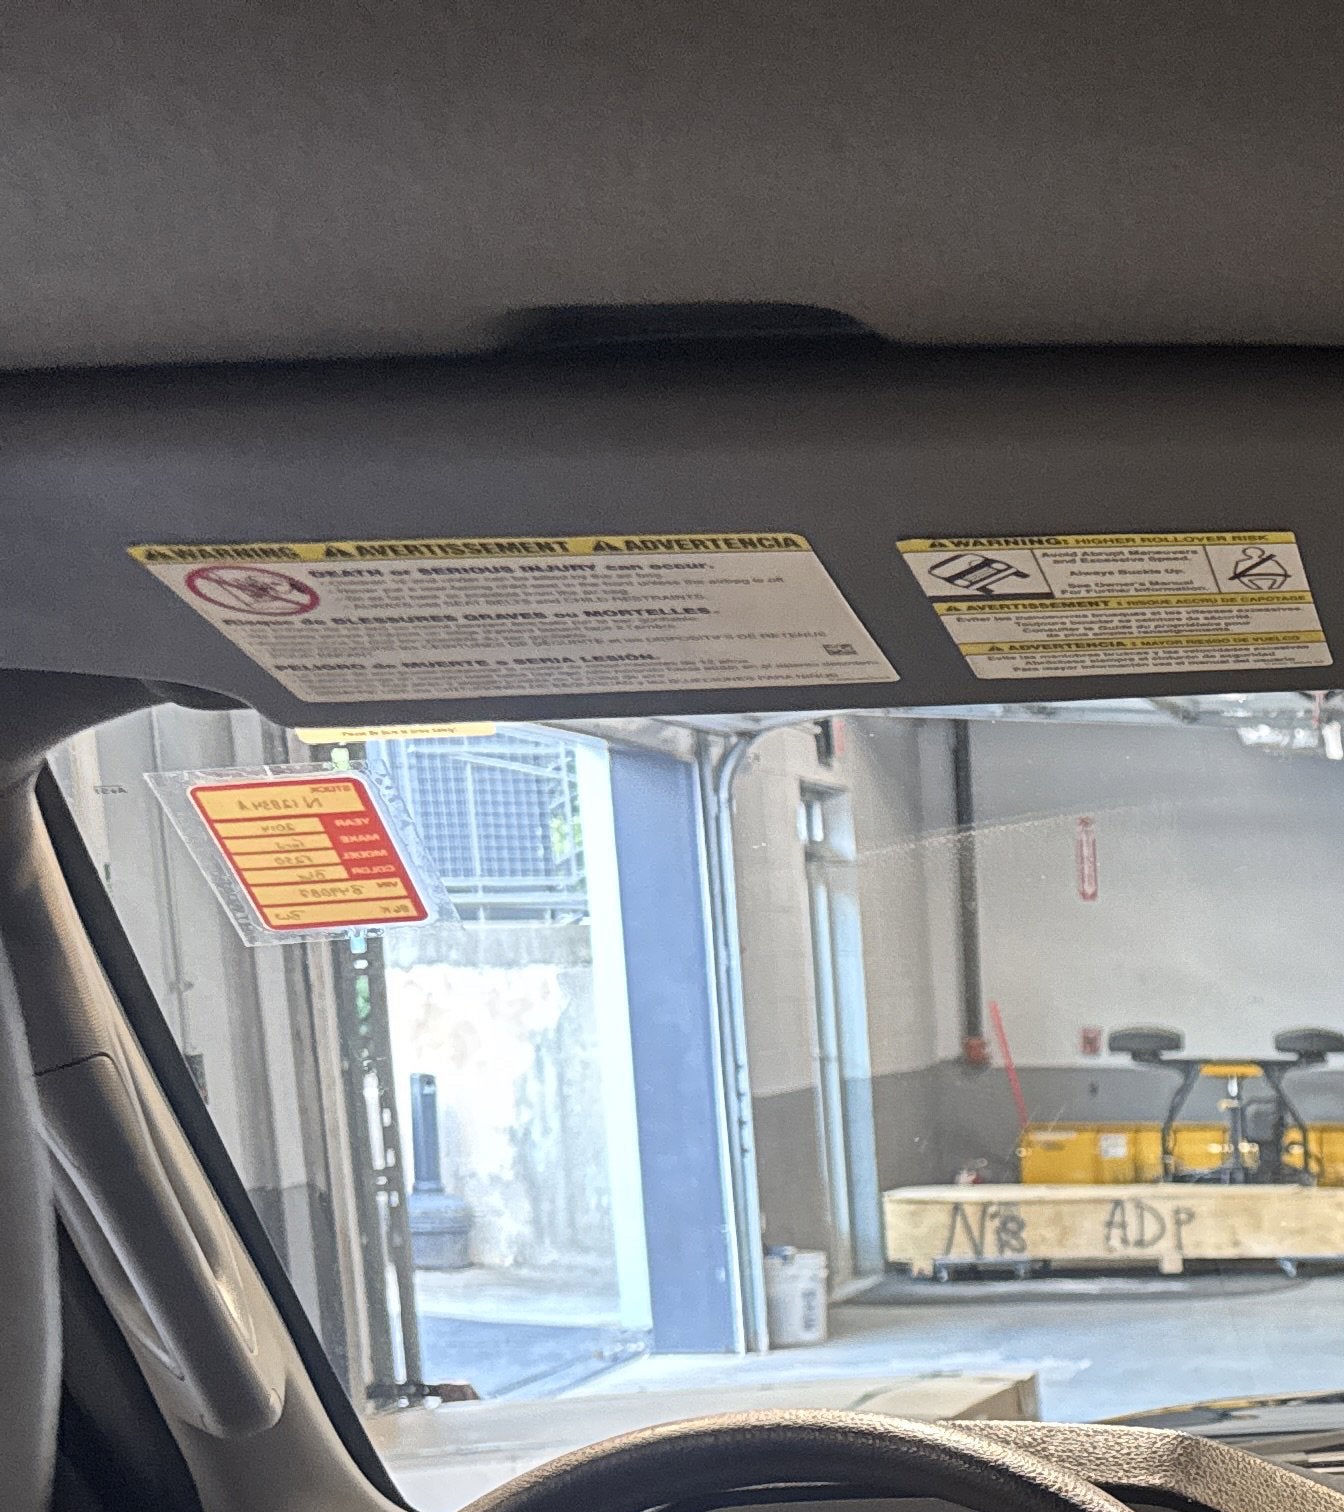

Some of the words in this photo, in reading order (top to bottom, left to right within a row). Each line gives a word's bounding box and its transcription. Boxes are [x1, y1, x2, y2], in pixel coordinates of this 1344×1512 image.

[354, 540, 570, 557] AVERTISSEMENT
[623, 536, 802, 551] ADVERTENCIA
[949, 537, 1068, 548] WARNING:
[1074, 536, 1136, 546] HIGHER
[1139, 534, 1227, 545] ROLLOVER
[1231, 534, 1269, 543] RISK
[171, 545, 300, 560] WARNING
[1103, 1199, 1198, 1251] ADP
